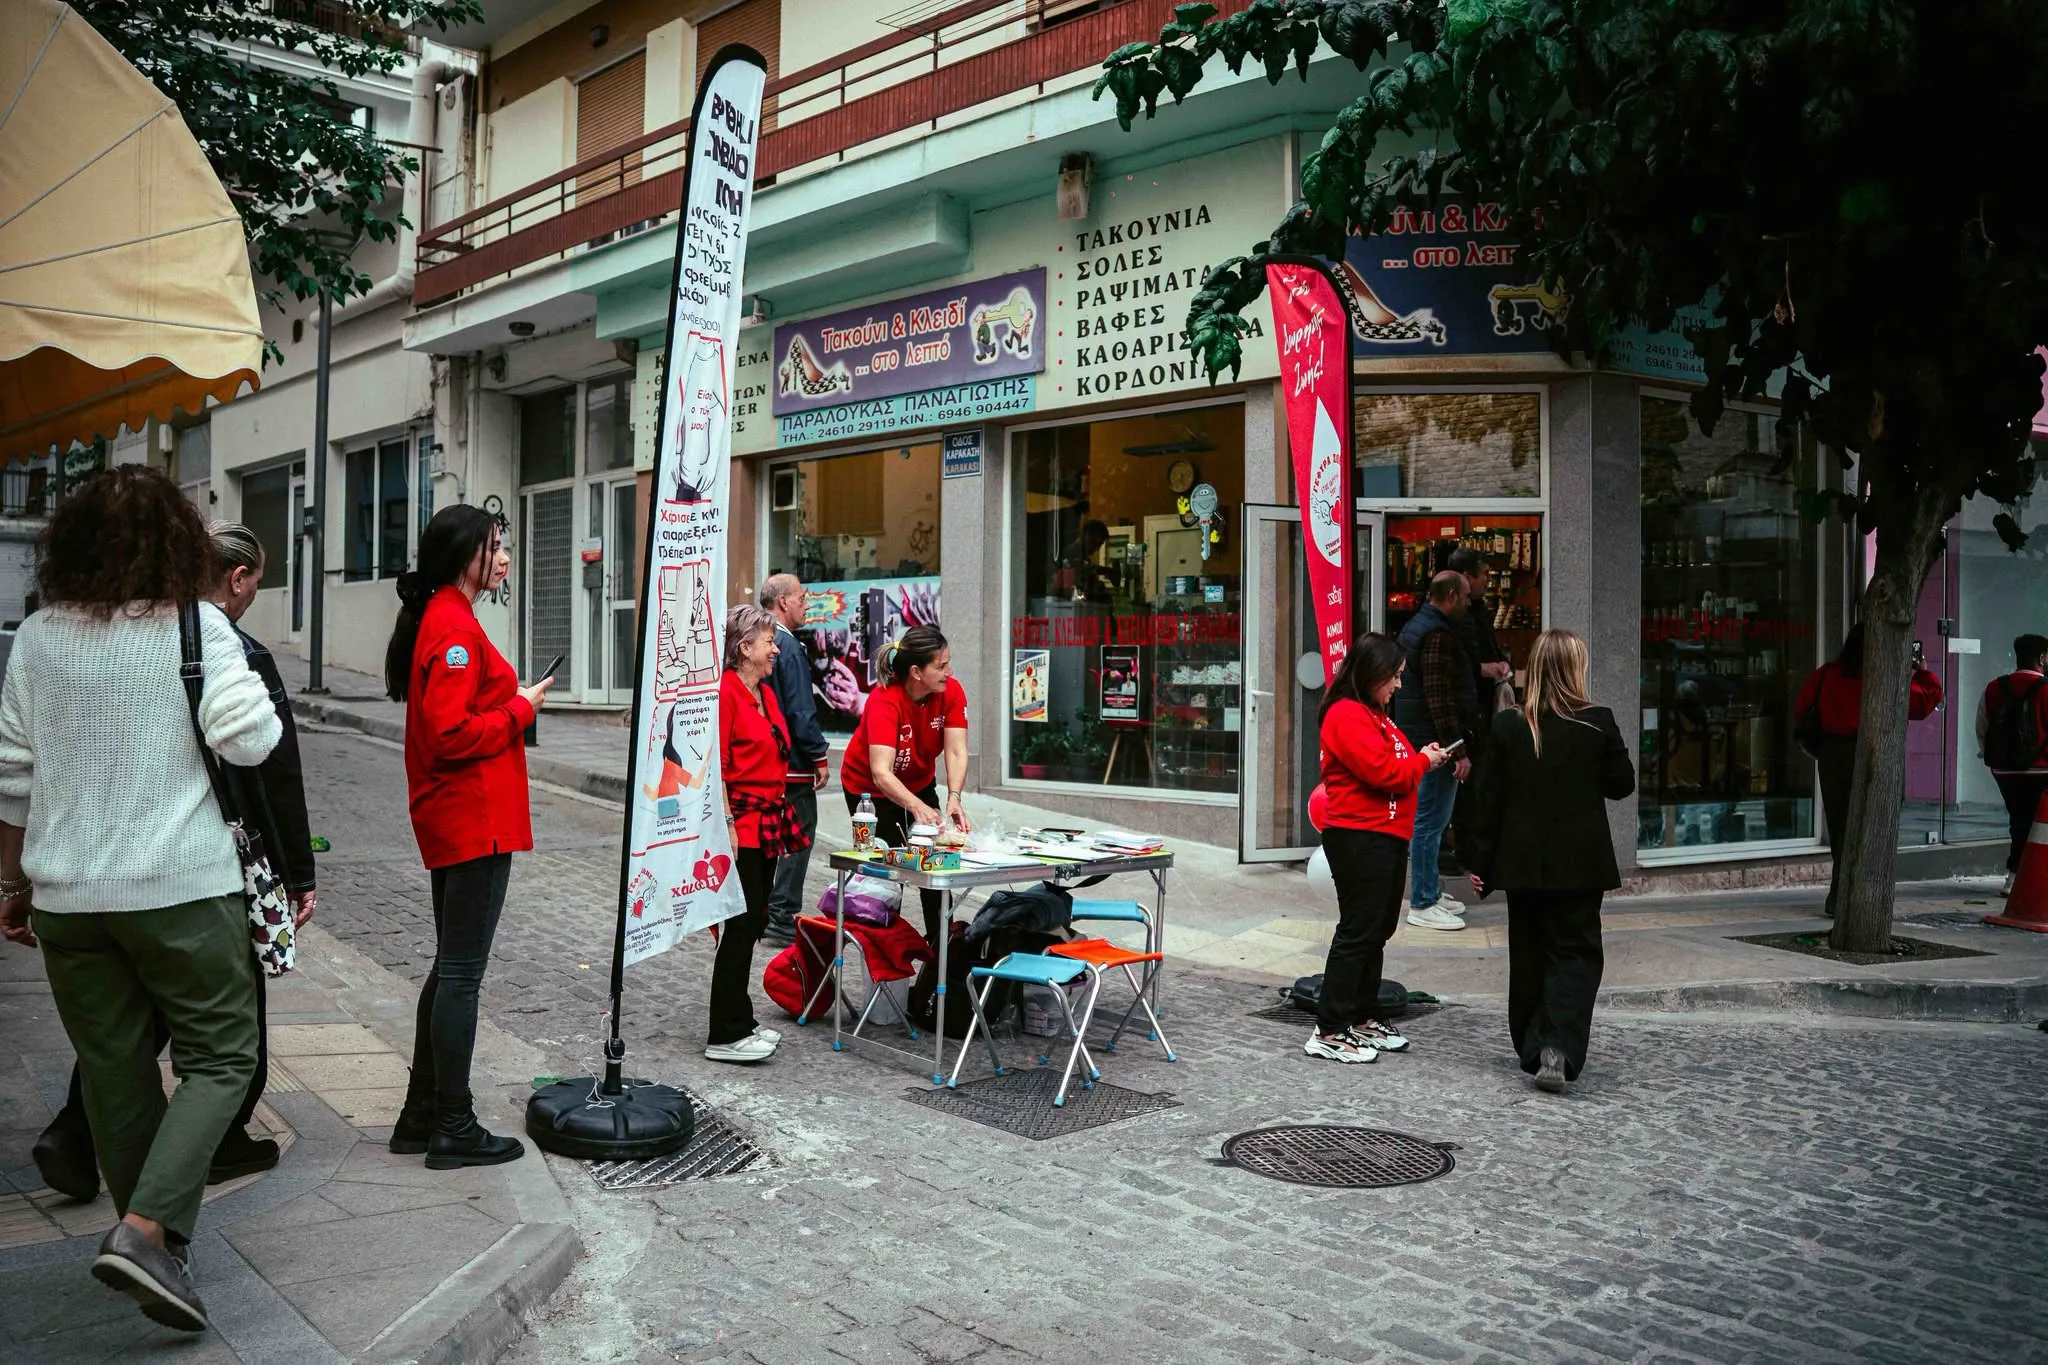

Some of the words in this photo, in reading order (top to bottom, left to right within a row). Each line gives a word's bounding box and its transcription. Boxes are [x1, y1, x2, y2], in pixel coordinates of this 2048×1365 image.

[1077, 204, 1212, 252] ΤΑΚΟΥΝΙΑ
[1077, 245, 1163, 281] ΣΟΛΕΣ
[1414, 247, 1459, 267] στο
[1077, 265, 1212, 309] ΡΑΨΙΜΑΤΑ
[822, 318, 887, 353] Τακούνι
[892, 313, 906, 338] &
[910, 297, 967, 336] Κλειδί
[1077, 305, 1165, 338] ΒΑΦΕΣ
[872, 350, 899, 373] στο
[905, 333, 950, 367] λεπτό
[782, 400, 895, 432] ΠΑΡΑΛΟΥΚΑΣ
[905, 378, 1029, 411] ΠΑΝΑΓΙΩΤΗΣ
[818, 425, 853, 437] 24610
[858, 418, 895, 431] 29119
[938, 406, 971, 420] 6946
[976, 398, 1029, 415] 904447
[946, 447, 979, 460] ΚΑΡΑΚΑΣΗ
[952, 435, 974, 447] ΟΔΟΣ
